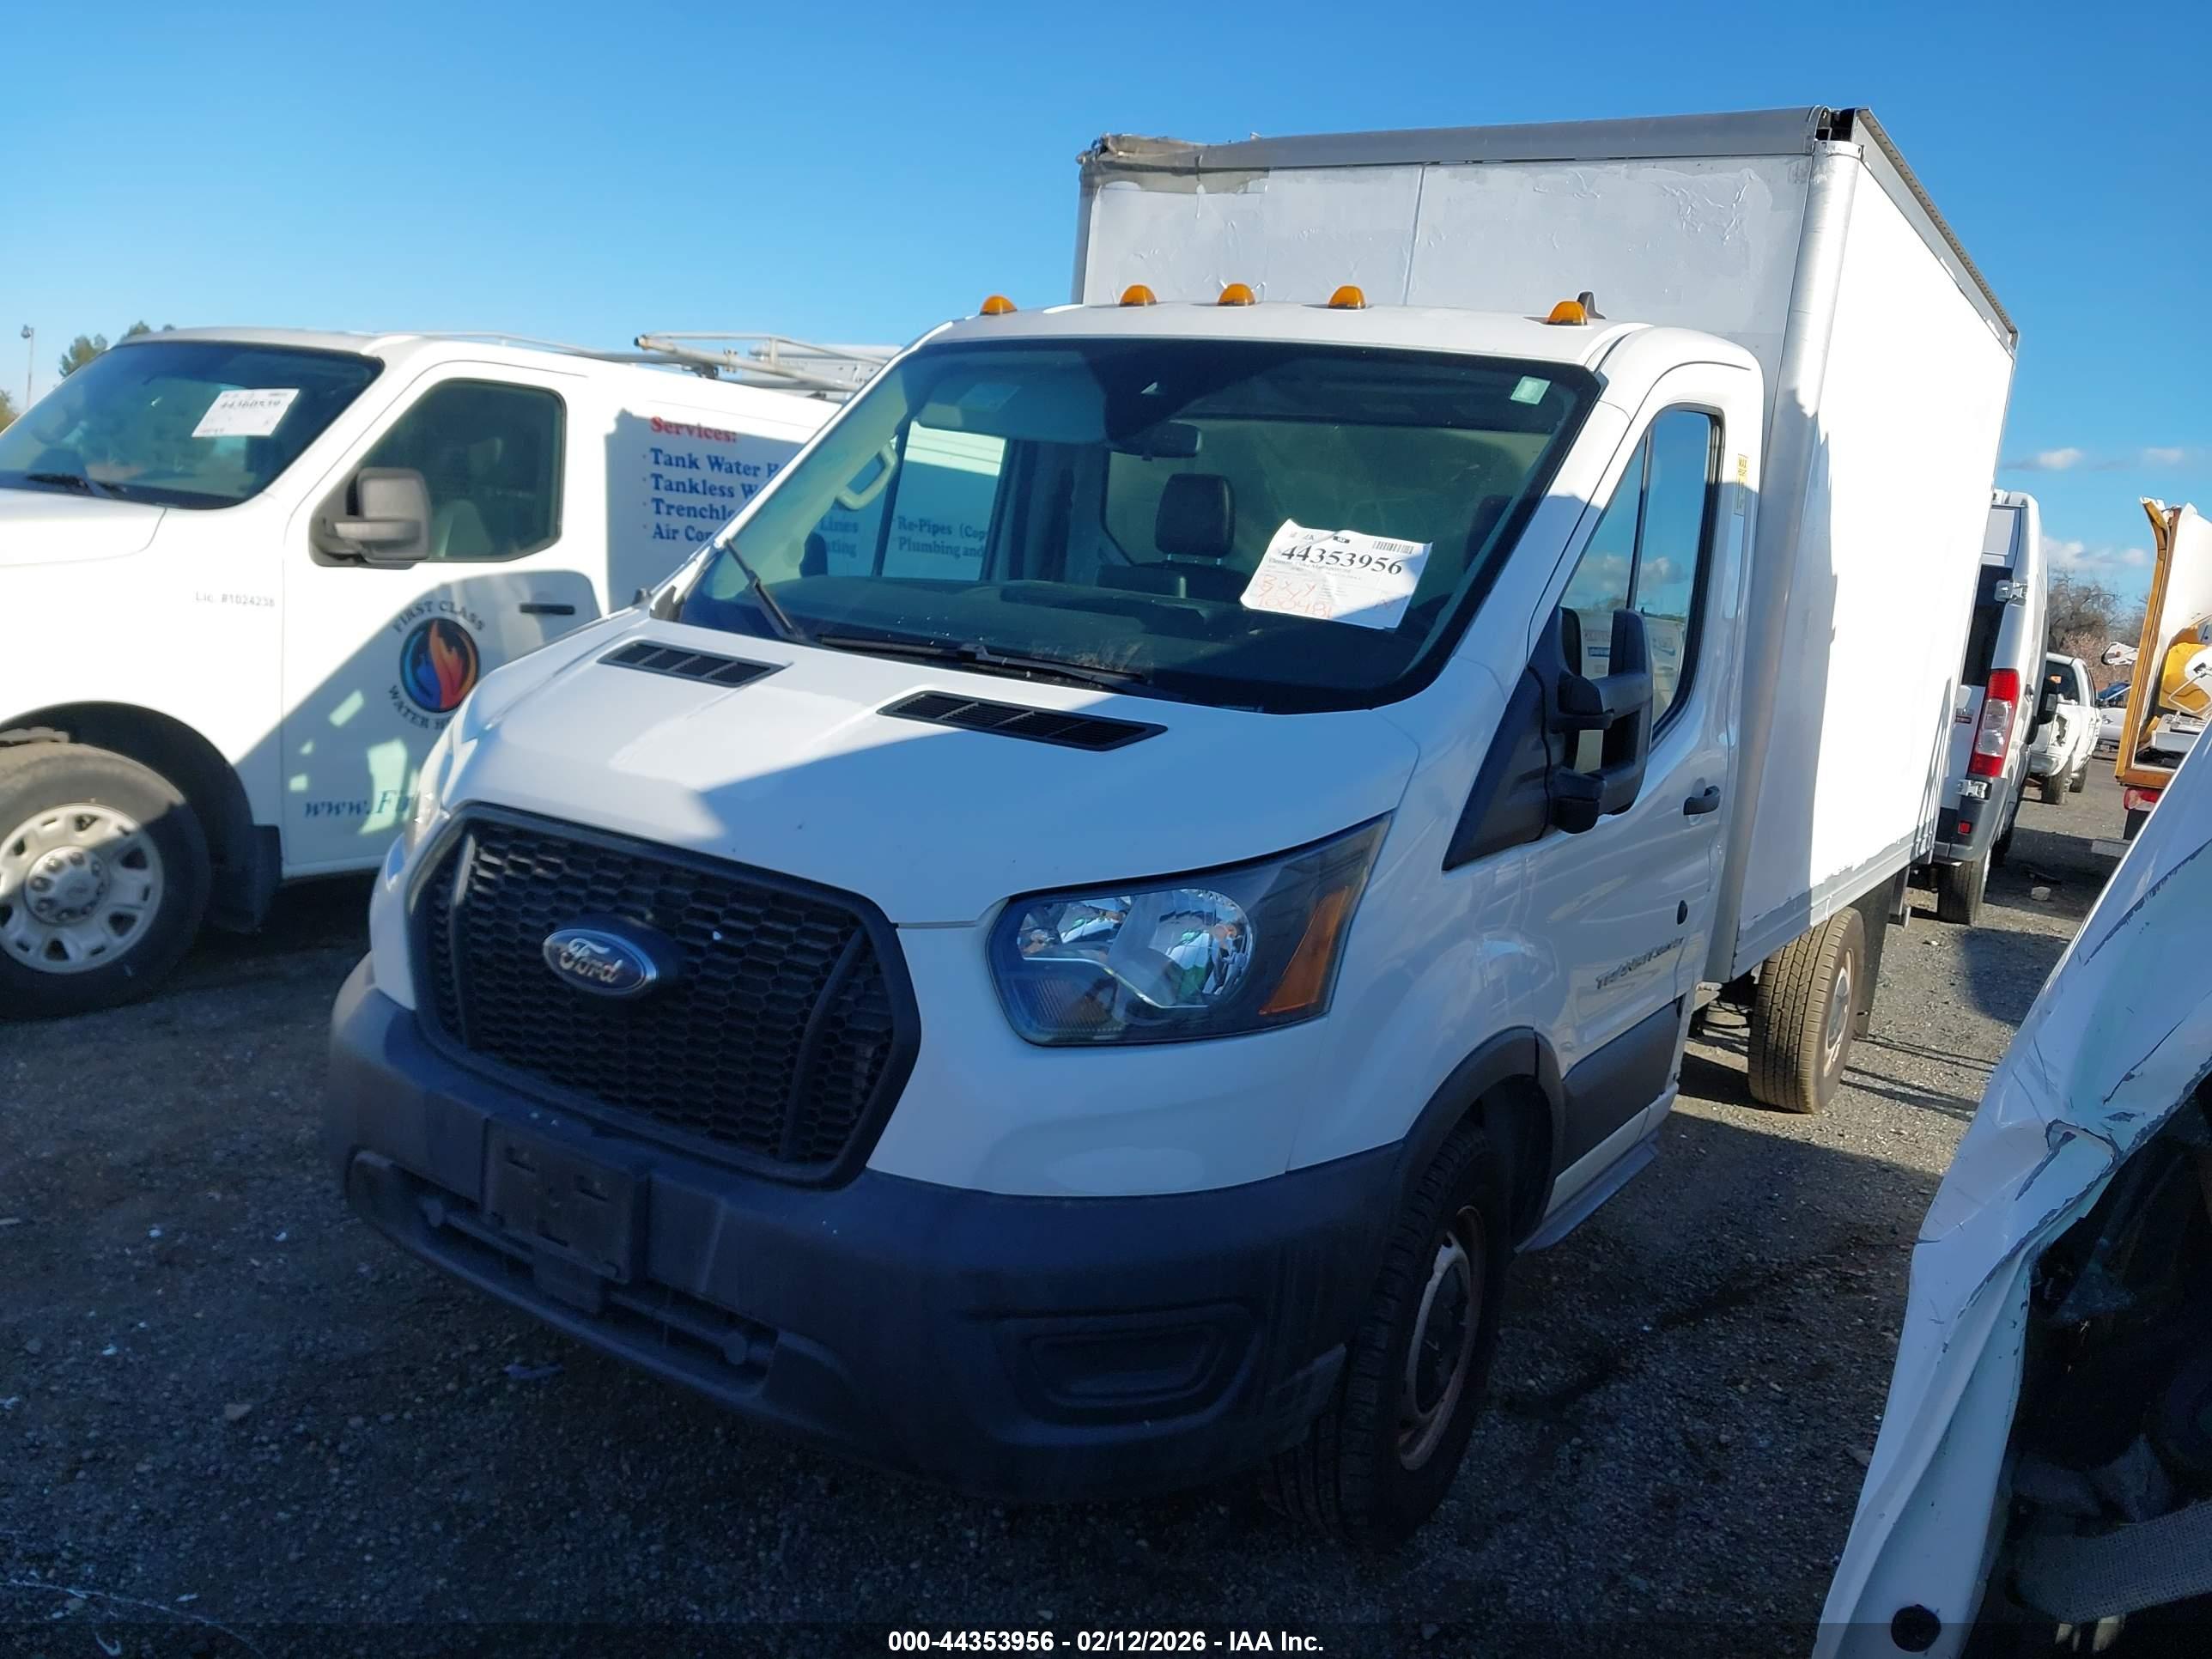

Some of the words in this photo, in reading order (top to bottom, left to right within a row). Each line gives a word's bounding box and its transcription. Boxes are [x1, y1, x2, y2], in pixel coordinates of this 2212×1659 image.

[650, 416, 738, 443] Services:
[649, 447, 701, 471] Tank
[706, 453, 762, 478] Water
[650, 472, 735, 498] Tankless
[740, 483, 759, 500] W
[652, 521, 680, 541] Air
[684, 524, 714, 543] Con
[896, 515, 953, 537] Re-Pipes
[959, 522, 988, 541] (Cop
[897, 536, 961, 559] Plumbing
[1281, 544, 1403, 575] 44353956
[392, 600, 433, 633] FIRST
[439, 599, 486, 631] CLASS
[388, 684, 429, 729] WATER
[558, 937, 624, 984] Ford
